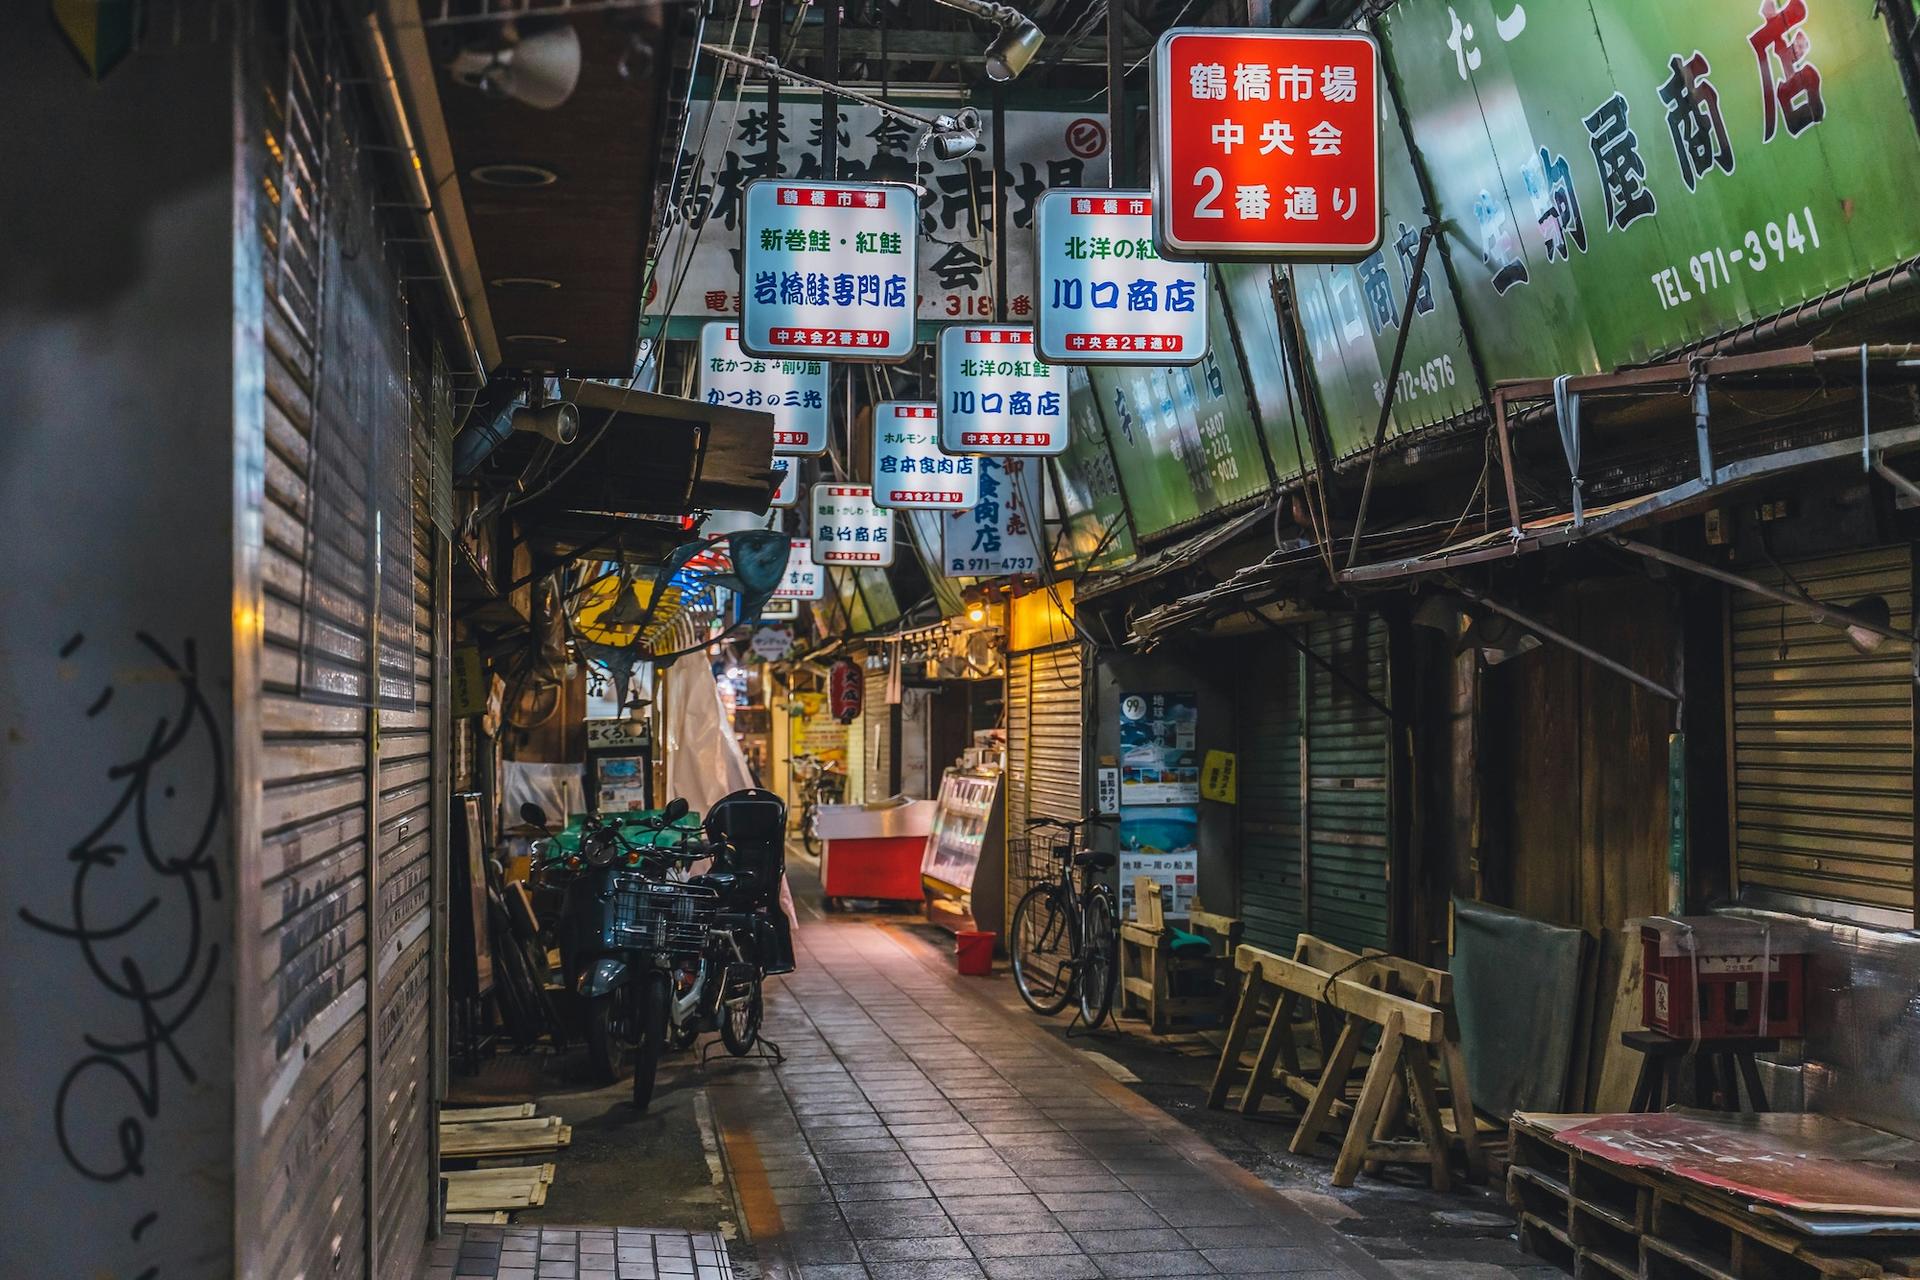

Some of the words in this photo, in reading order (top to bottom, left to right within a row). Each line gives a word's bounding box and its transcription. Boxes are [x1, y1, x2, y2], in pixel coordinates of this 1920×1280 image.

[1189, 62, 1358, 104] 鶴橋市場
[1210, 119, 1343, 157] 中央会
[783, 189, 880, 208] 鶴橋市場
[1193, 165, 1358, 221] 2番通り
[1076, 198, 1152, 214] 鶴橋市
[760, 228, 902, 254] 新巻鮭・紅鮭
[1064, 236, 1163, 260] 北洋の紅
[1651, 266, 1692, 311] TEL
[1690, 206, 1821, 296] 971-3941
[753, 270, 907, 308] 岩橋鮭専門店
[1051, 278, 1196, 313] 川口商店
[777, 330, 883, 346] 中央会2番通り
[1072, 336, 1177, 350] 中央会2番通り
[710, 357, 821, 375] 花かつお・削り節
[960, 359, 1050, 377] 北洋の紅鮭
[952, 390, 1060, 416] 川口商店
[967, 434, 1046, 446] 中央会2番通り
